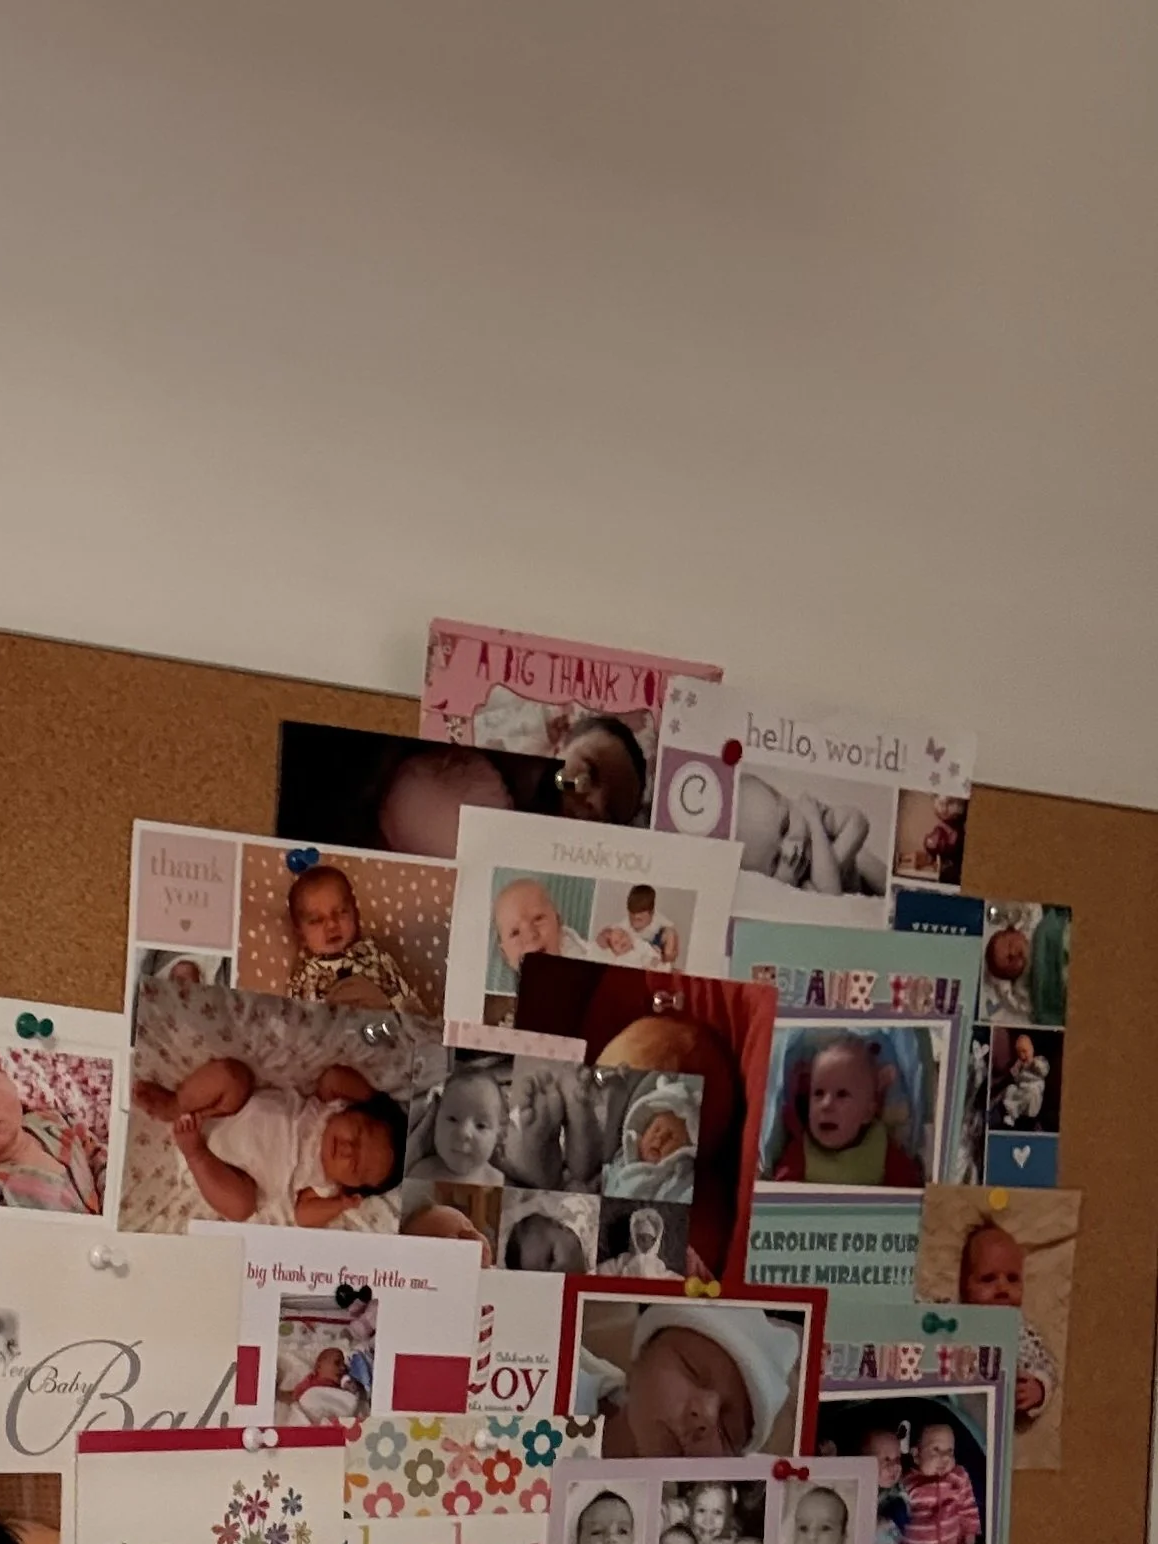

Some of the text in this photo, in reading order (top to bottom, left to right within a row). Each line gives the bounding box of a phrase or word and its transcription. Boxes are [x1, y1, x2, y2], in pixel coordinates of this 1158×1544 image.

[475, 641, 490, 681] A
[745, 711, 817, 764] hello,
[680, 774, 707, 816] C
[151, 848, 224, 884] thank
[164, 886, 210, 915] you
[750, 1231, 920, 1253] CAROLINE FOR OUR
[247, 1262, 266, 1289] big
[272, 1263, 306, 1283] thank
[309, 1270, 333, 1291] you
[373, 1268, 405, 1288] little
[750, 1263, 811, 1284] LITTLE
[27, 1365, 94, 1405] Baby
